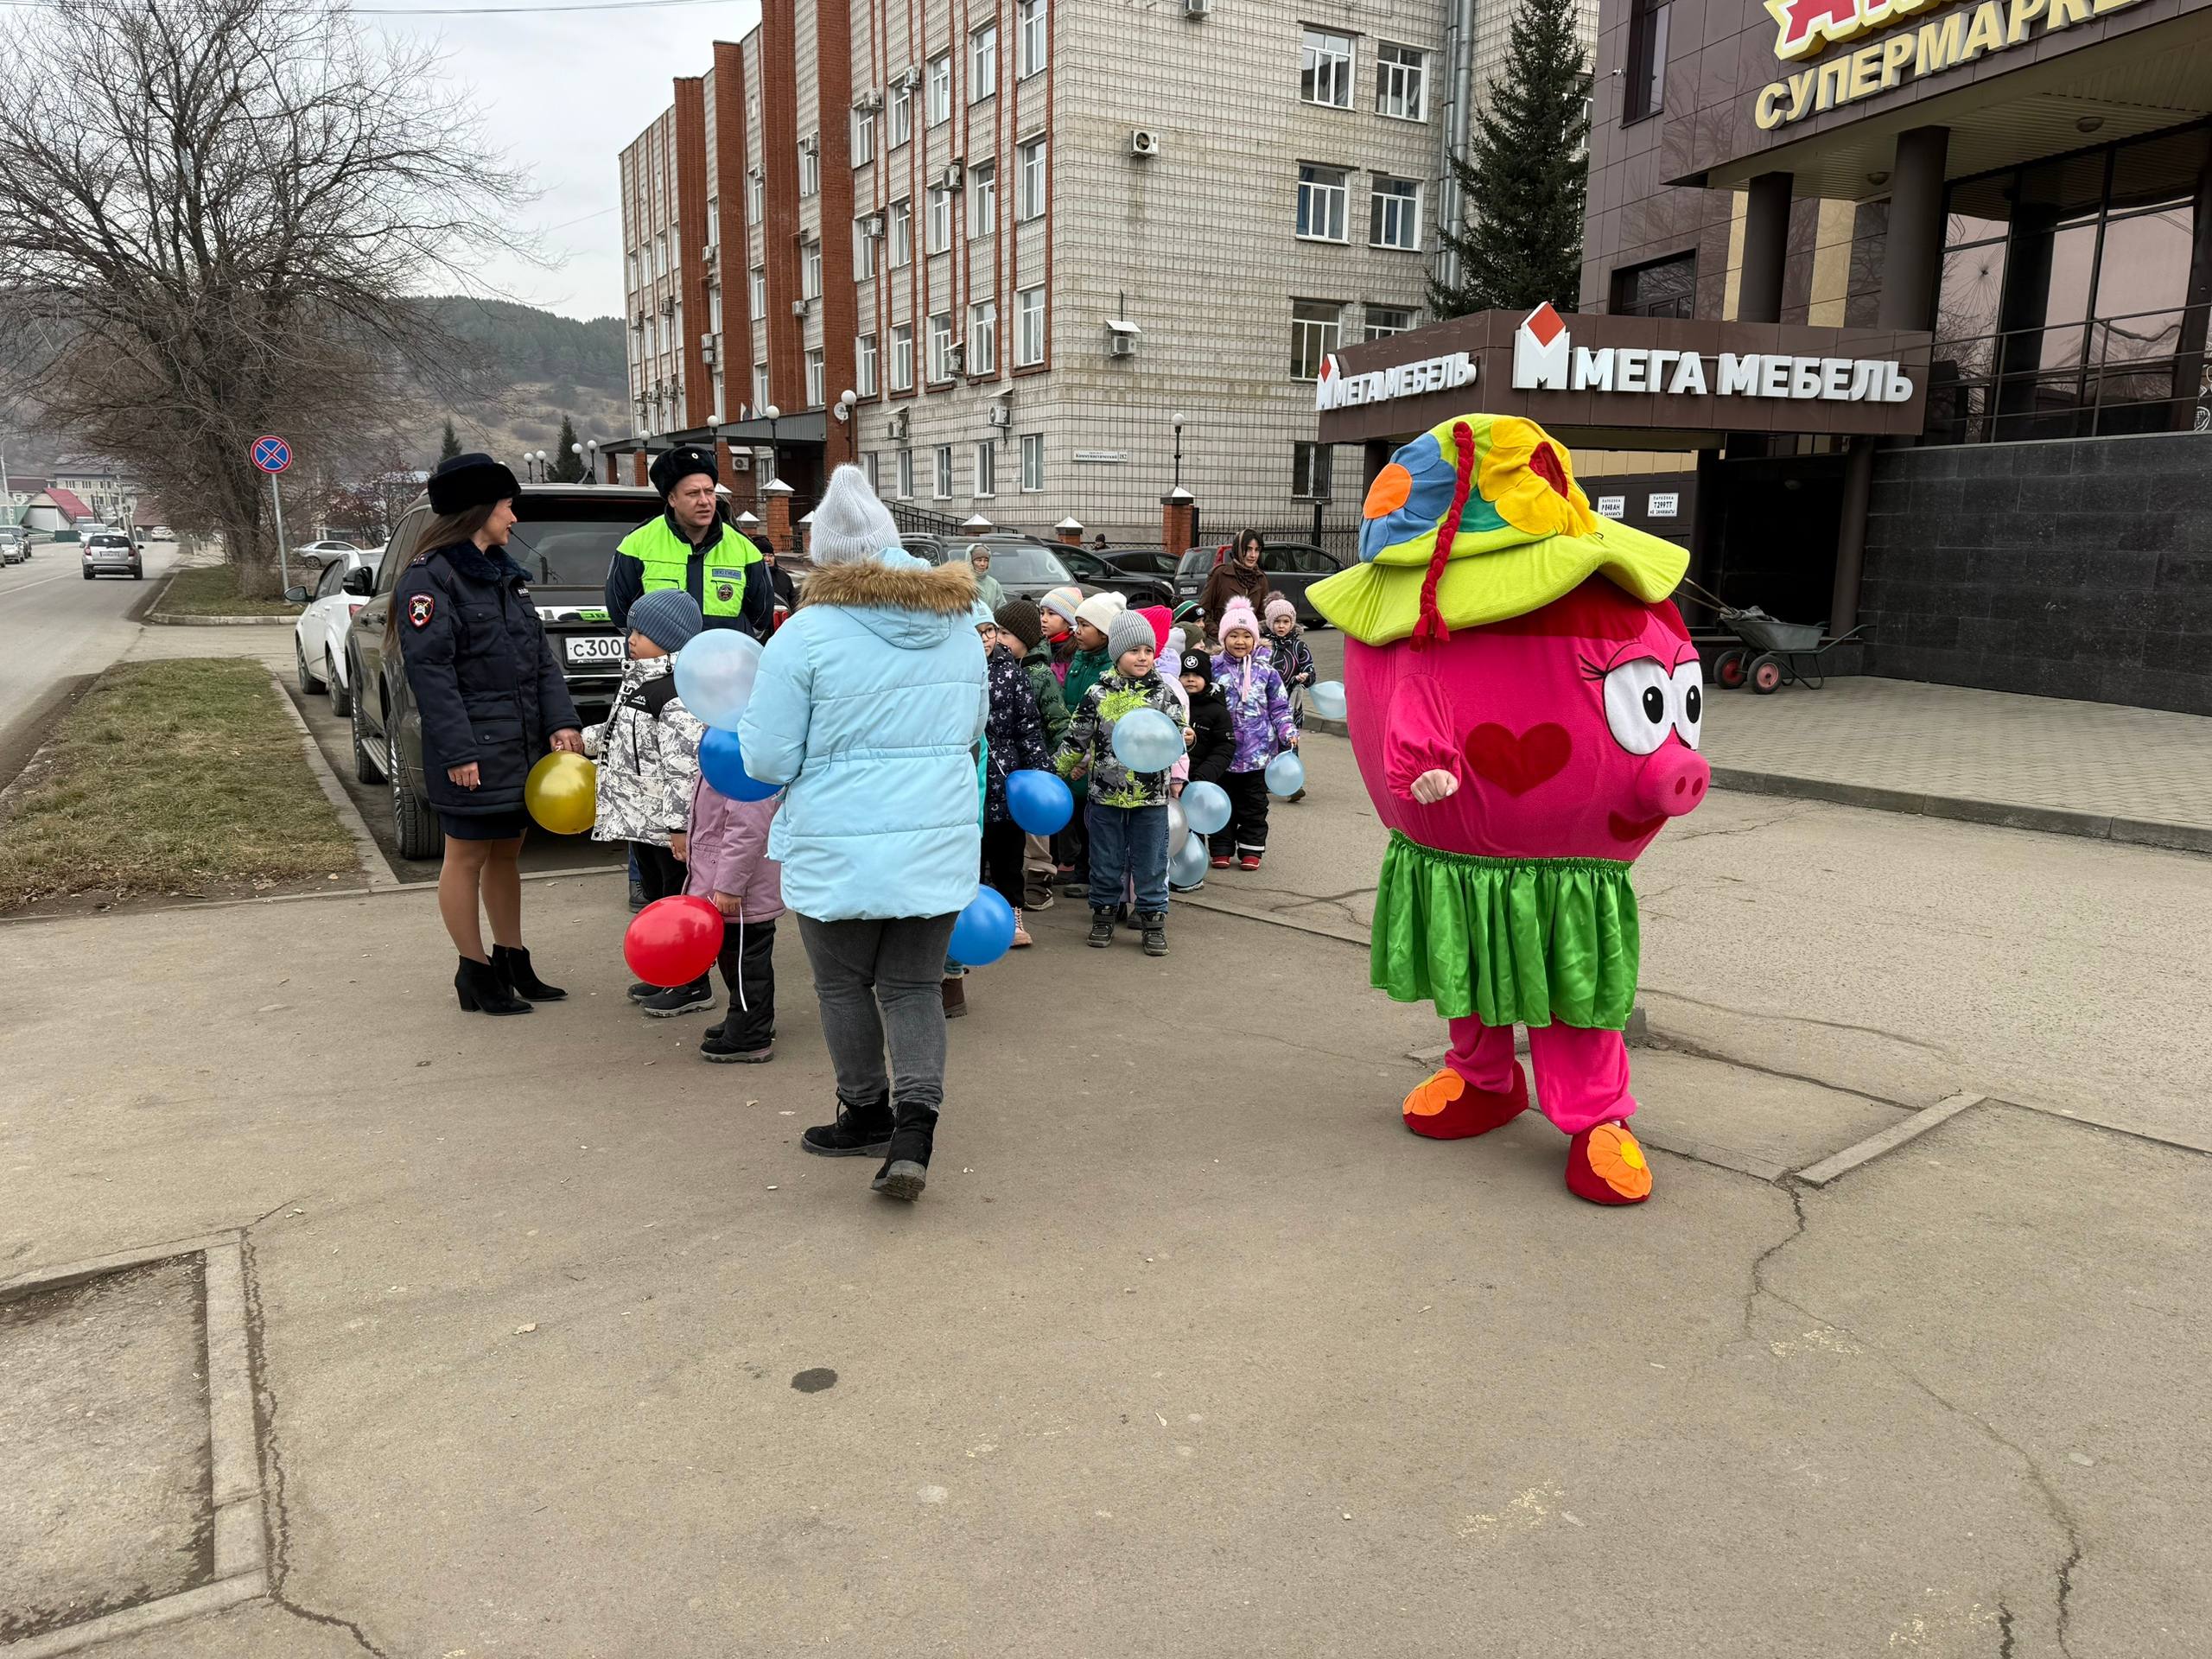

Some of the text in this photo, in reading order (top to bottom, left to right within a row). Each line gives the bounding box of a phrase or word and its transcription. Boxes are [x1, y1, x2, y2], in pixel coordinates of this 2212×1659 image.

[1755, 0, 2145, 130] СУПЕРМАРК
[1333, 371, 1386, 409] МЕГА
[1385, 352, 1477, 399] МЕБЕЛЬ
[1570, 346, 1707, 395] МЕГА
[1716, 353, 1914, 403] МЕБЕЛЬ
[574, 639, 624, 657] С300
